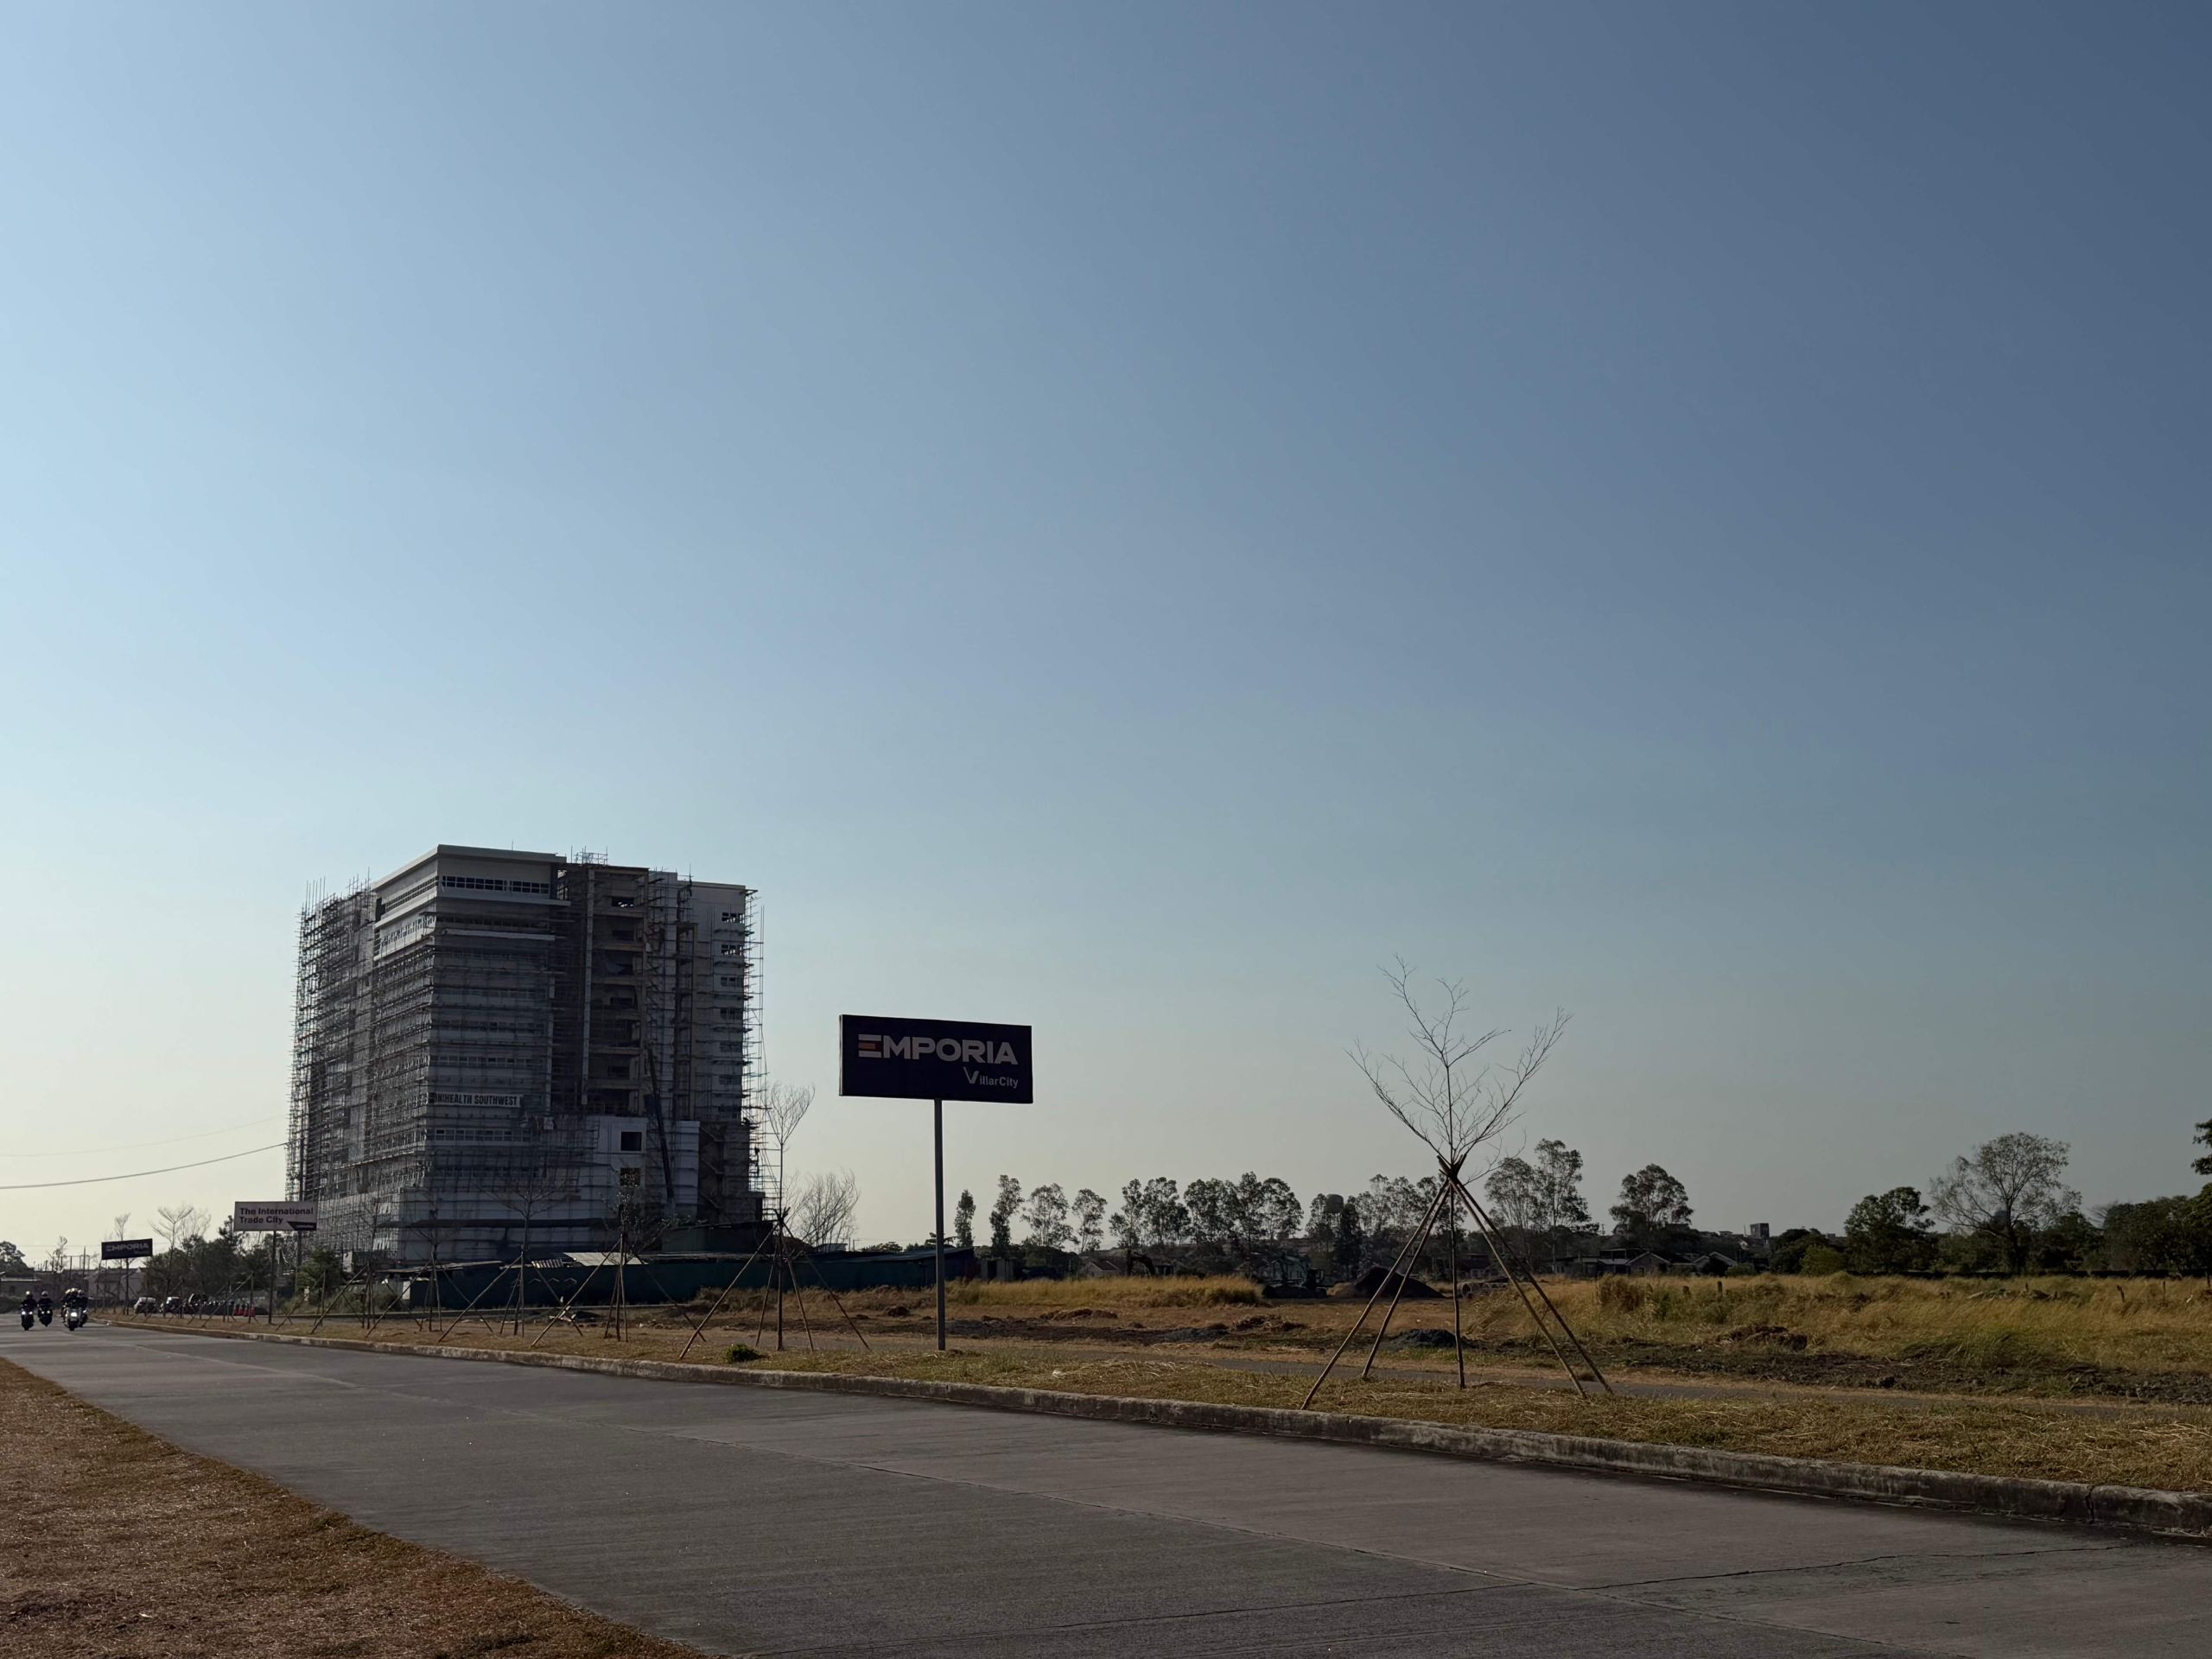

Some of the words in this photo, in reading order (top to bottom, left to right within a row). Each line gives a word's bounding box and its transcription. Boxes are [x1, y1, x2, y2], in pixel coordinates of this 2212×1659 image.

[858, 1033, 1019, 1065] EMPORIA
[474, 1094, 518, 1106] SOUTHWEST
[266, 1216, 283, 1224] City
[105, 1243, 149, 1252] EMPORIA
